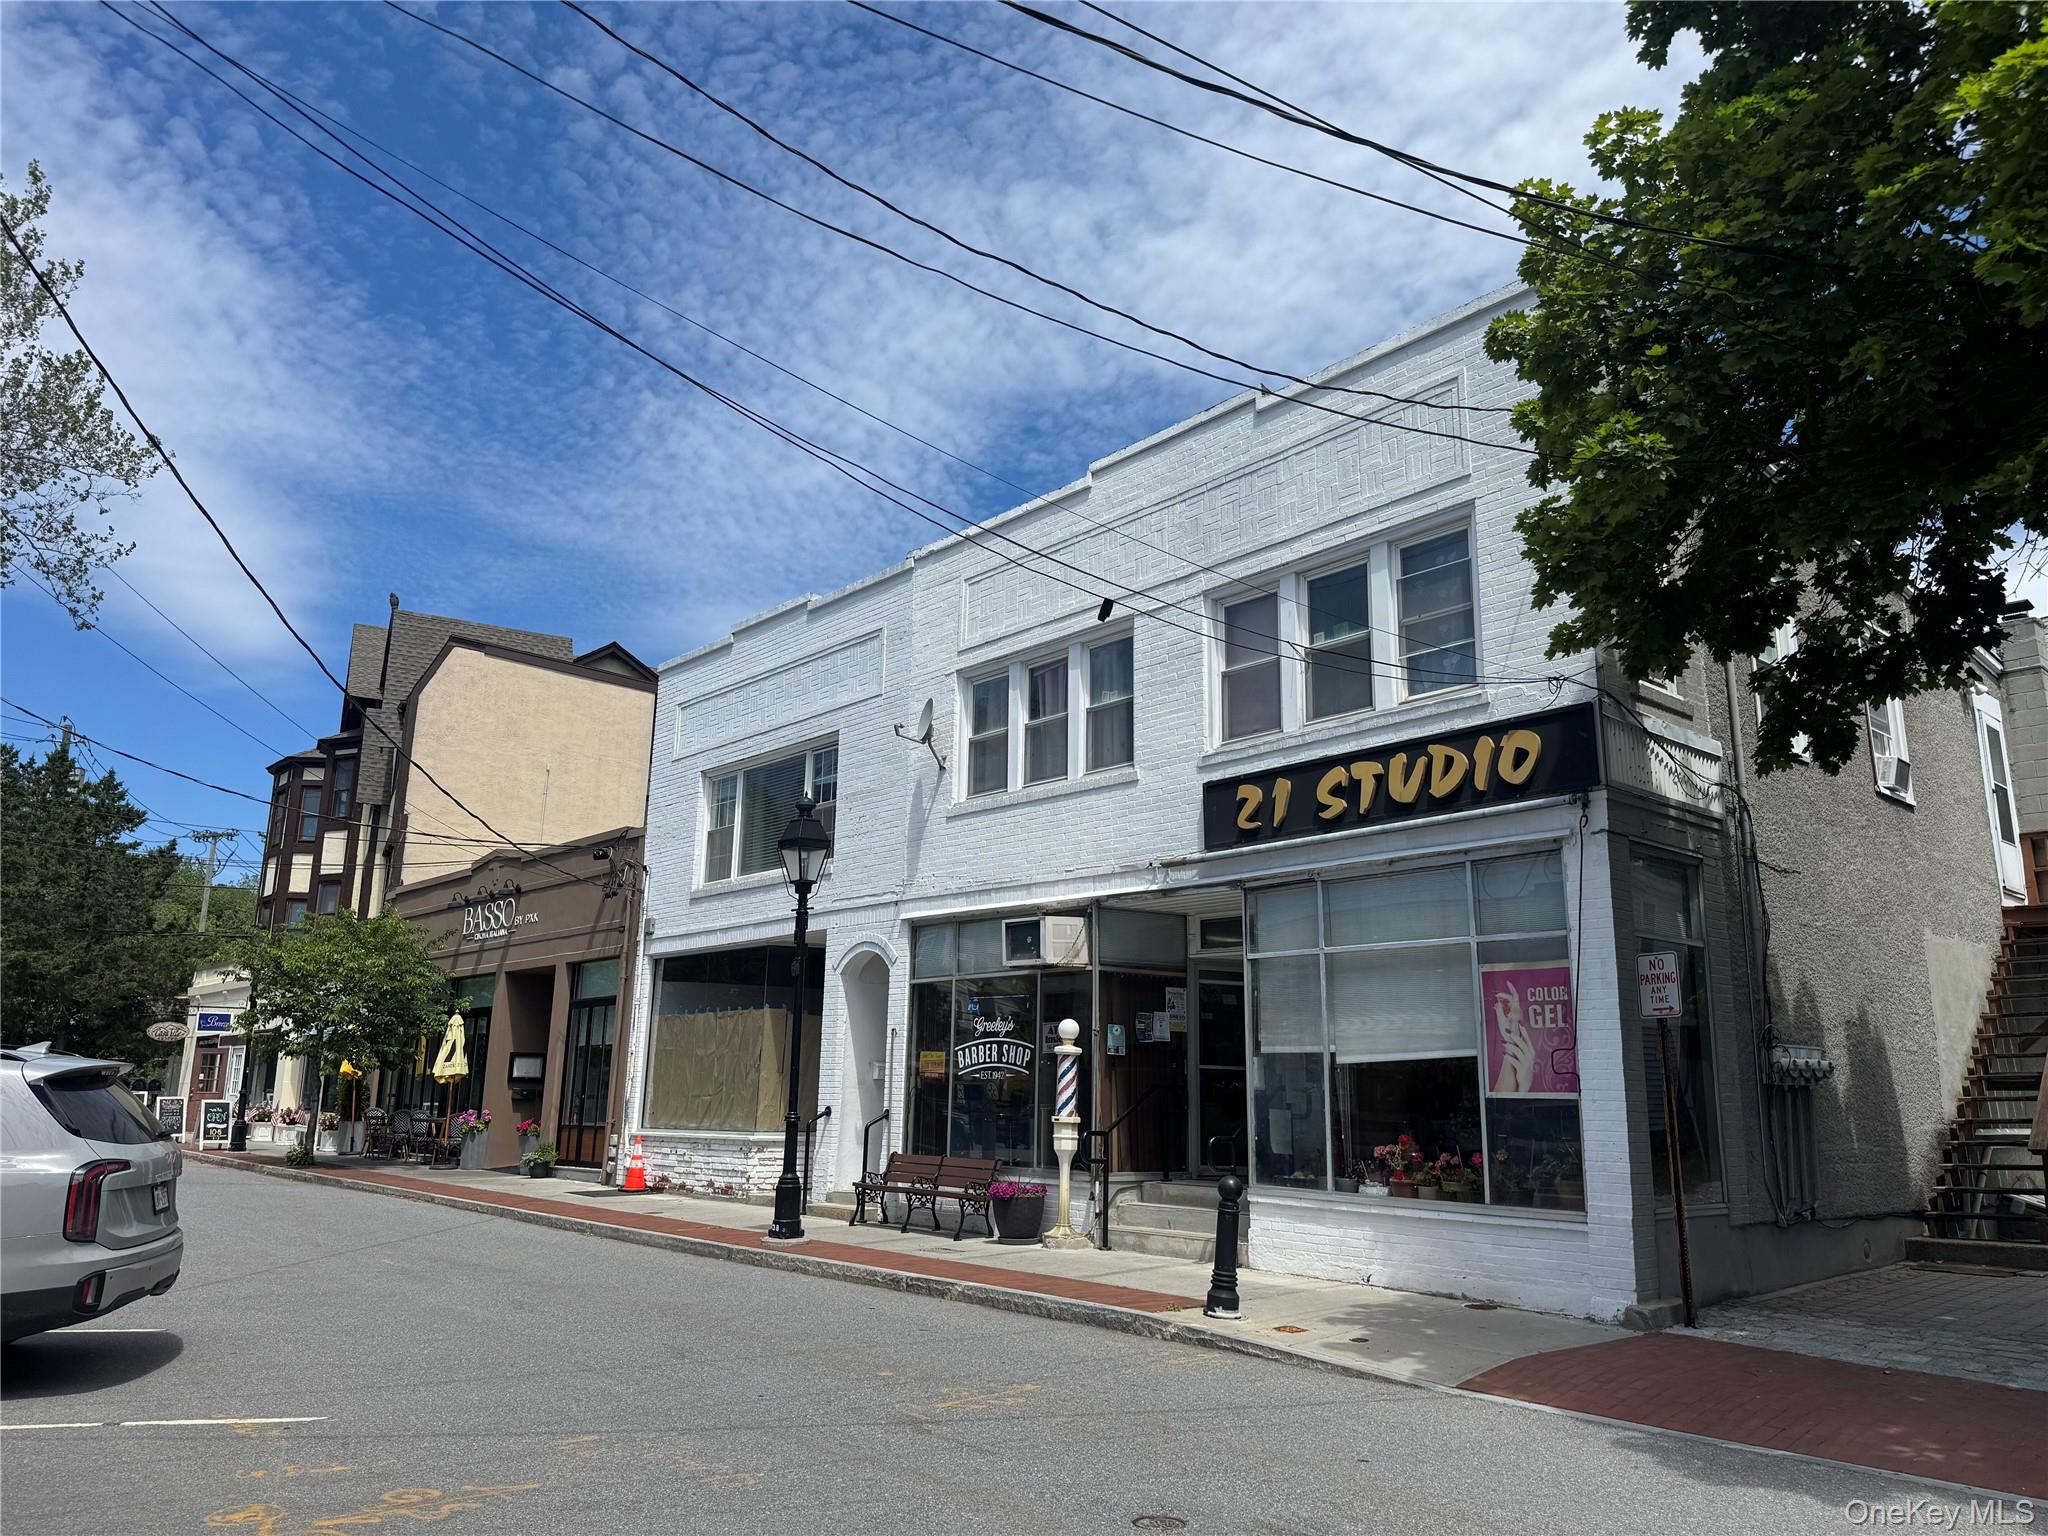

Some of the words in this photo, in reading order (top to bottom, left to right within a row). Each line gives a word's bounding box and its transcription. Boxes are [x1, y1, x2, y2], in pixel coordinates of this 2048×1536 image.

[1236, 777, 1291, 830] 21
[1316, 729, 1541, 820] STUDIO
[462, 898, 516, 935] BASSO
[514, 915, 524, 926] BY
[1649, 958, 1665, 971] NO
[1640, 972, 1676, 986] PARKING
[1527, 986, 1568, 1002] COLOR
[1651, 985, 1667, 995] ANY
[1650, 995, 1670, 1004] TIME
[1528, 1004, 1568, 1029] GEL
[973, 1016, 1015, 1037] Greeley's
[957, 1043, 998, 1068] BARBER
[1002, 1044, 1031, 1067] SHOP
